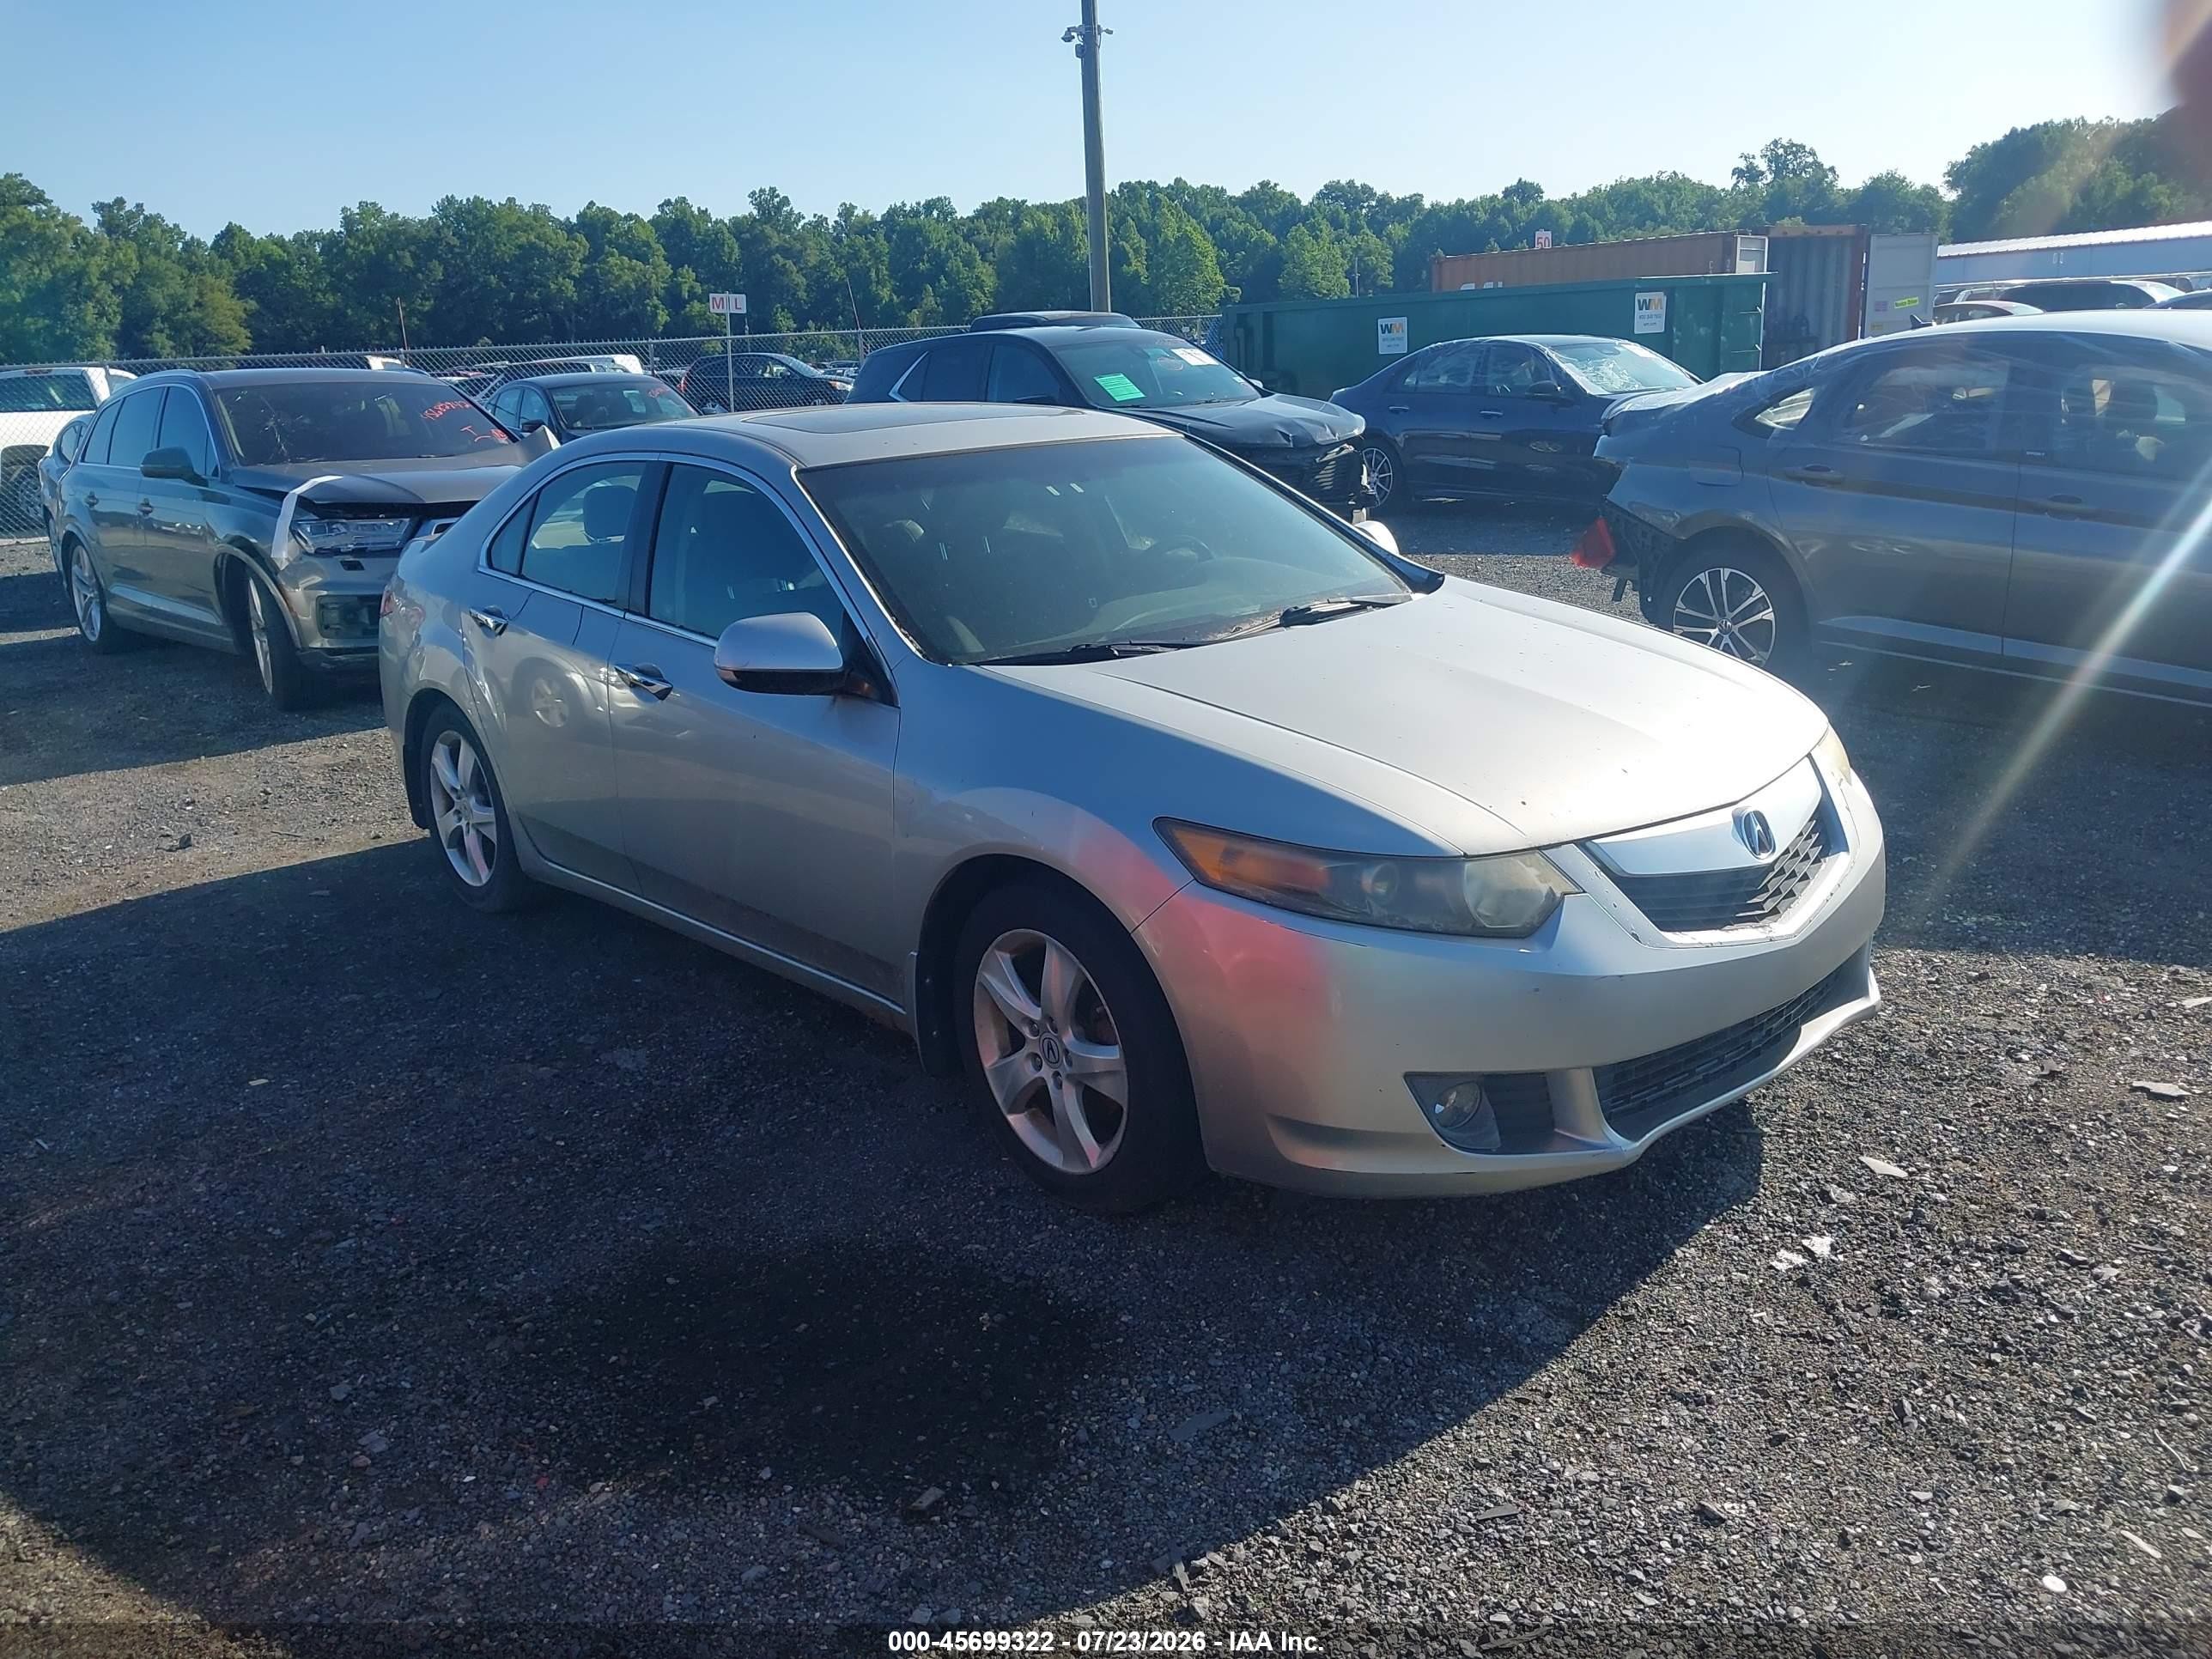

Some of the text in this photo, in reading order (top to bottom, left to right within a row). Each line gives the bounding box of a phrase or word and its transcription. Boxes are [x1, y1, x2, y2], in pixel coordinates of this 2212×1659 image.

[1536, 236, 1551, 249] 50
[711, 296, 742, 310] M L
[1637, 298, 1663, 311] WM
[1380, 323, 1405, 334] WM
